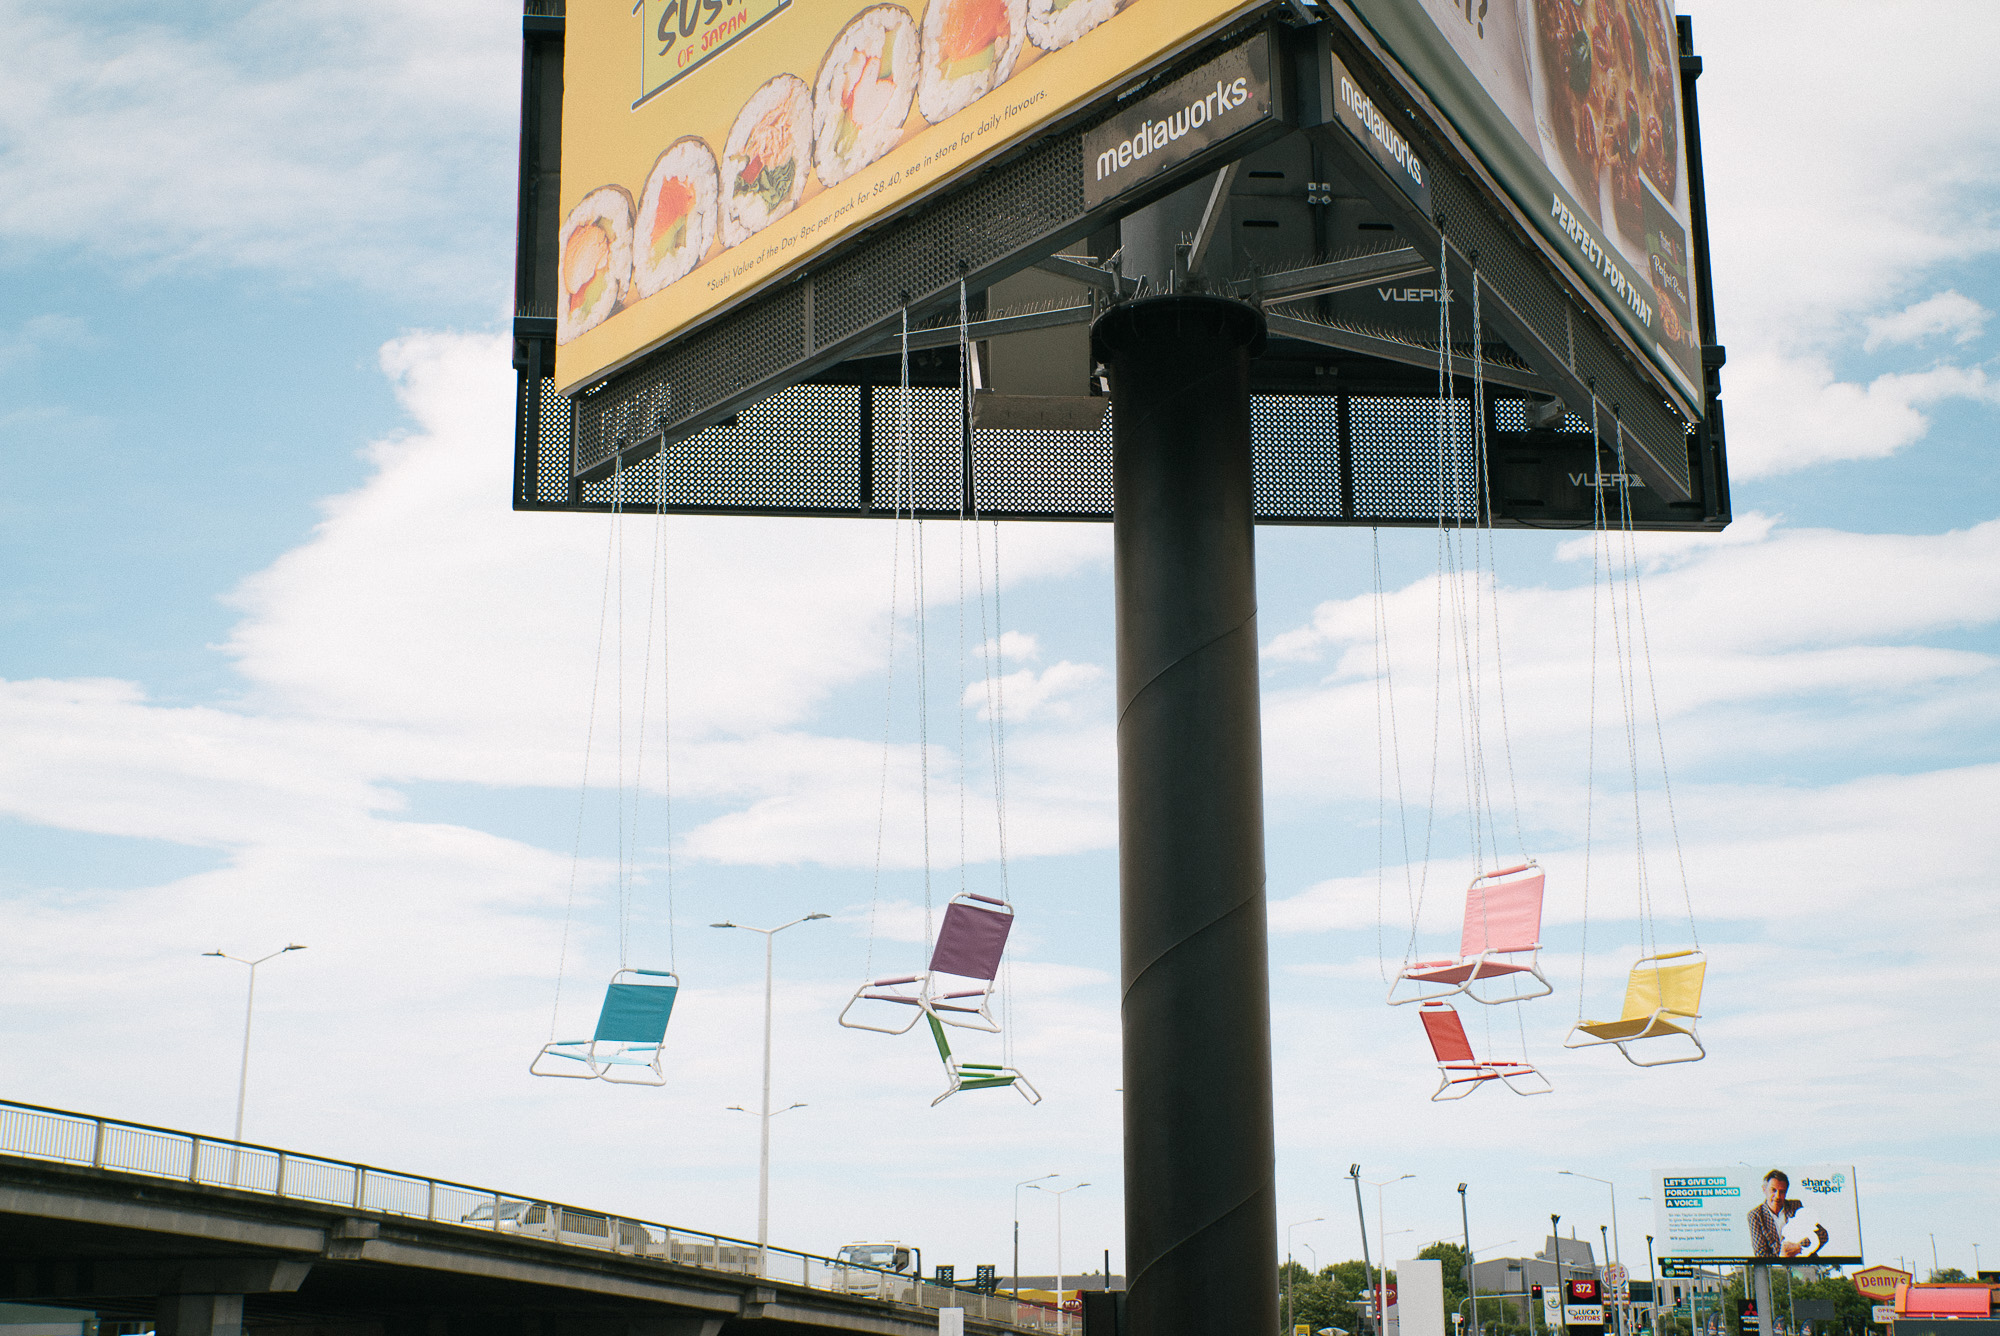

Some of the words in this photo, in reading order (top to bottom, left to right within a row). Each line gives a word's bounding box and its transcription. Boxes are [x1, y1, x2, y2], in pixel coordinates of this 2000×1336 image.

[677, 44, 694, 68] OF
[701, 8, 747, 51] JAPAN
[732, 259, 755, 278] Value
[756, 249, 765, 264] of
[766, 245, 779, 259] the
[781, 234, 798, 251] Day
[800, 223, 816, 240] 8pc
[817, 213, 833, 232] per
[833, 196, 855, 222] pack
[857, 191, 870, 205] for
[905, 162, 921, 178] see
[923, 155, 932, 168] in
[935, 141, 958, 161] store
[961, 130, 975, 147] for
[977, 114, 1001, 137] daily
[1004, 89, 1048, 120] flavours.
[1551, 193, 1603, 269] PERFECT
[1603, 254, 1625, 298] FOR
[1626, 280, 1653, 328] THAT
[1665, 1178, 1686, 1186] LET'S
[1687, 1178, 1706, 1186] GIVE
[1708, 1178, 1726, 1186] OUR
[1801, 1177, 1831, 1187] share
[1715, 1188, 1739, 1196] MOKO
[1812, 1186, 1842, 1195] super
[1674, 1199, 1701, 1207] VOICE.
[1575, 1283, 1592, 1293] 372
[1065, 1300, 1080, 1308] KIA
